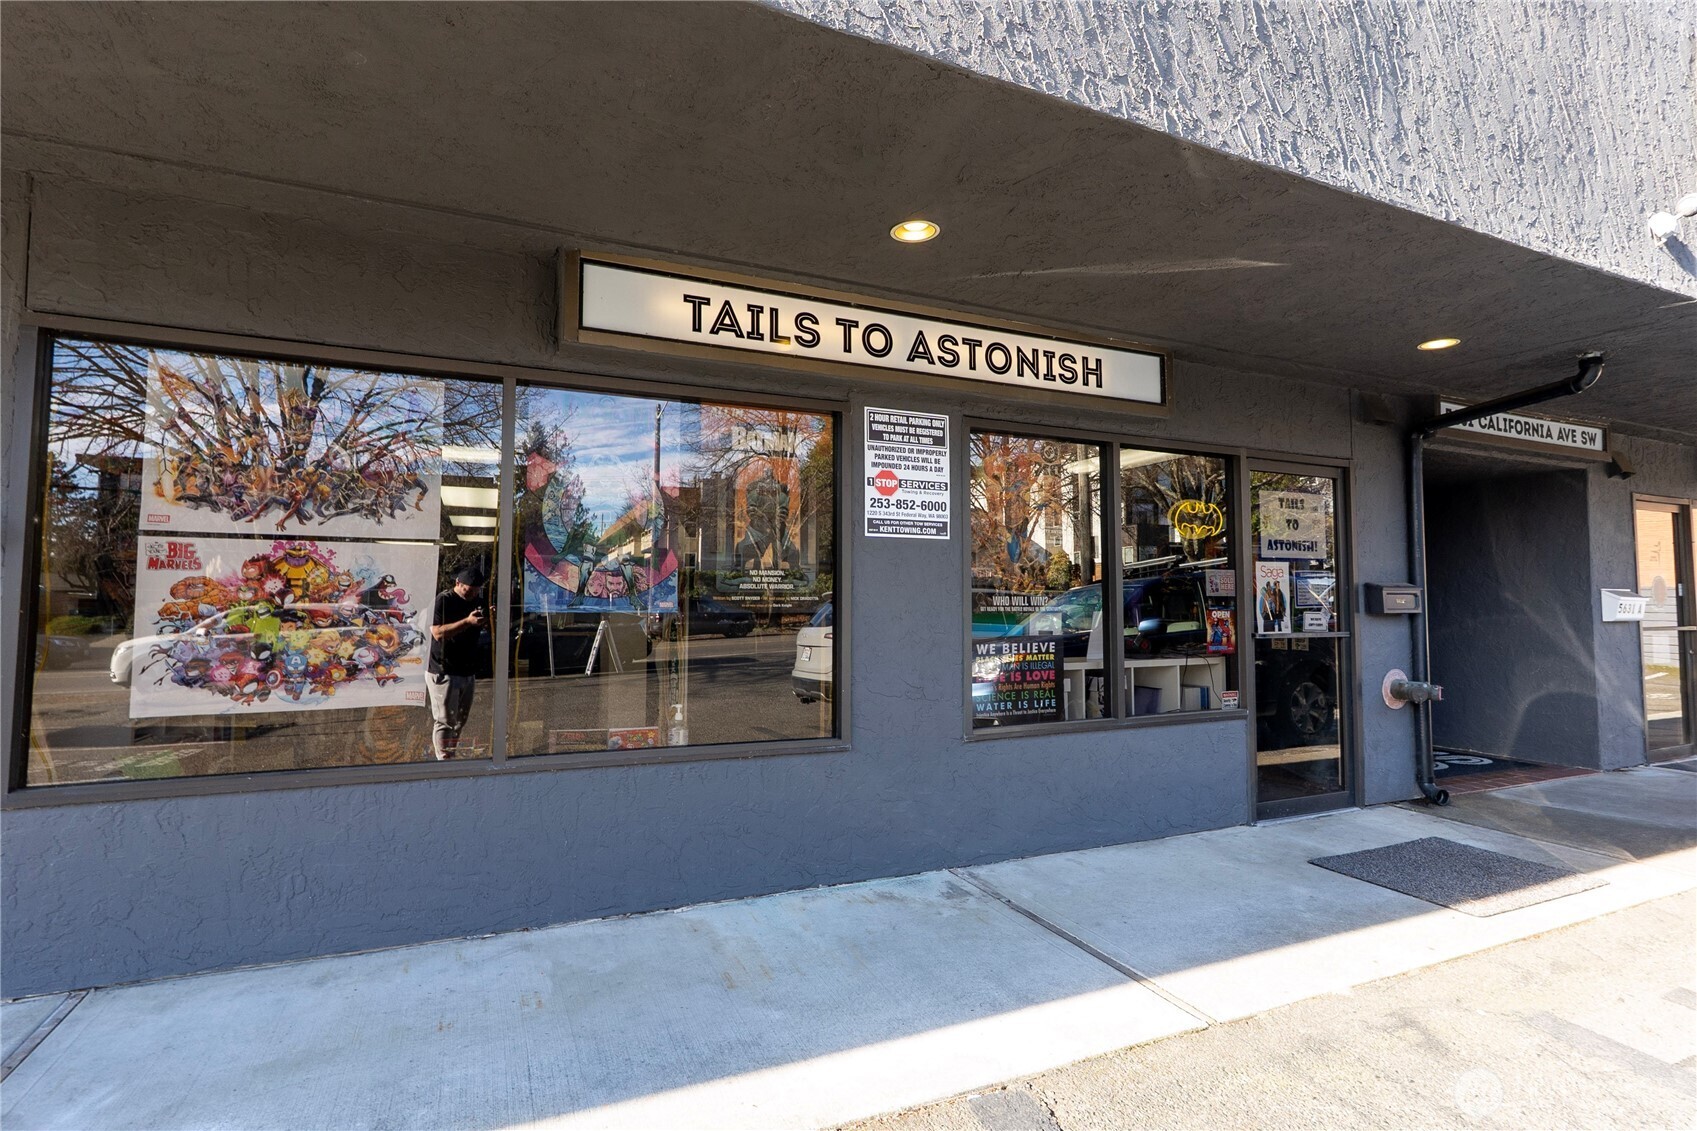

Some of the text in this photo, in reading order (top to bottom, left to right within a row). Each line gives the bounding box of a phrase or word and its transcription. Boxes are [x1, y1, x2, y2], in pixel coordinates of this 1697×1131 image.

[683, 294, 1103, 389] TAILS TO ASTONISH
[875, 414, 889, 422] HOUR
[890, 415, 908, 424] RETAIL
[909, 417, 931, 426] PARKING
[932, 420, 944, 428] ONLY
[872, 423, 894, 432] VEHICLES
[916, 428, 943, 437] REGISTERED
[1478, 415, 1553, 440] CALIFORNIA
[1557, 426, 1577, 444] AVE
[1581, 430, 1597, 446] SW
[867, 444, 906, 453] UNAUTHORIZED
[916, 448, 947, 457] IMPROPERLY
[896, 455, 920, 463] VEHICLES
[876, 479, 897, 487] STOP
[901, 480, 946, 490] SERVICES
[870, 498, 947, 512] 253-852-6000
[880, 526, 936, 534] KENTTOWING.COM
[1286, 518, 1299, 530] TO
[166, 542, 196, 560] BIG
[1267, 539, 1318, 552] ASTONISH!
[1260, 565, 1284, 579] Saga
[993, 596, 1048, 606] WHO WILL WIN?
[1212, 610, 1230, 618] OPEN
[1618, 603, 1635, 614] 5631
[976, 642, 1056, 654] WE BELIEVE
[1011, 672, 1021, 681] IS
[1026, 670, 1056, 681] LOVE
[976, 690, 1055, 702] SCIENCE IS REAL
[976, 699, 1056, 711] WATER IS LIFE
